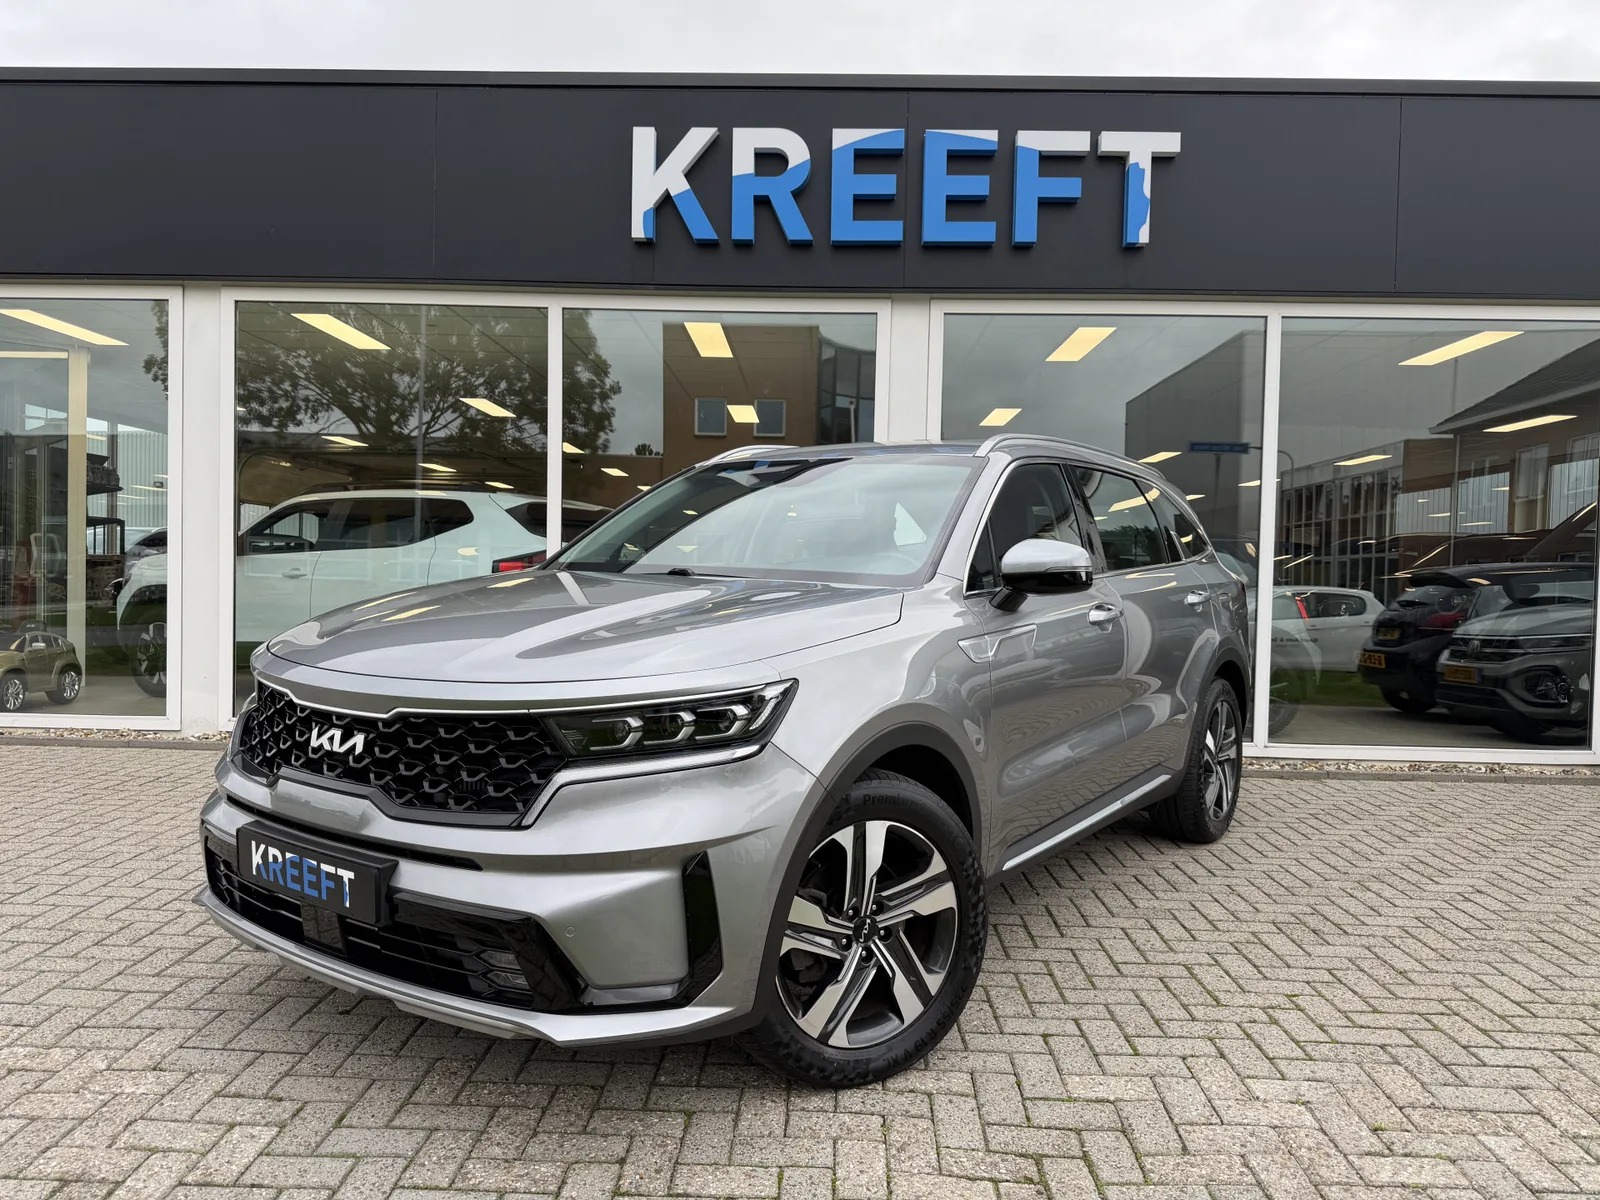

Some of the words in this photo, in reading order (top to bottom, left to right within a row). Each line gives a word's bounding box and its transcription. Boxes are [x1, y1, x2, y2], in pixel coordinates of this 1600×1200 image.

[631, 126, 1181, 247] KREEFT
[310, 726, 366, 756] KIA
[251, 840, 355, 908] KREEFT
[914, 1037, 928, 1051] 19
[926, 1028, 937, 1040] R
